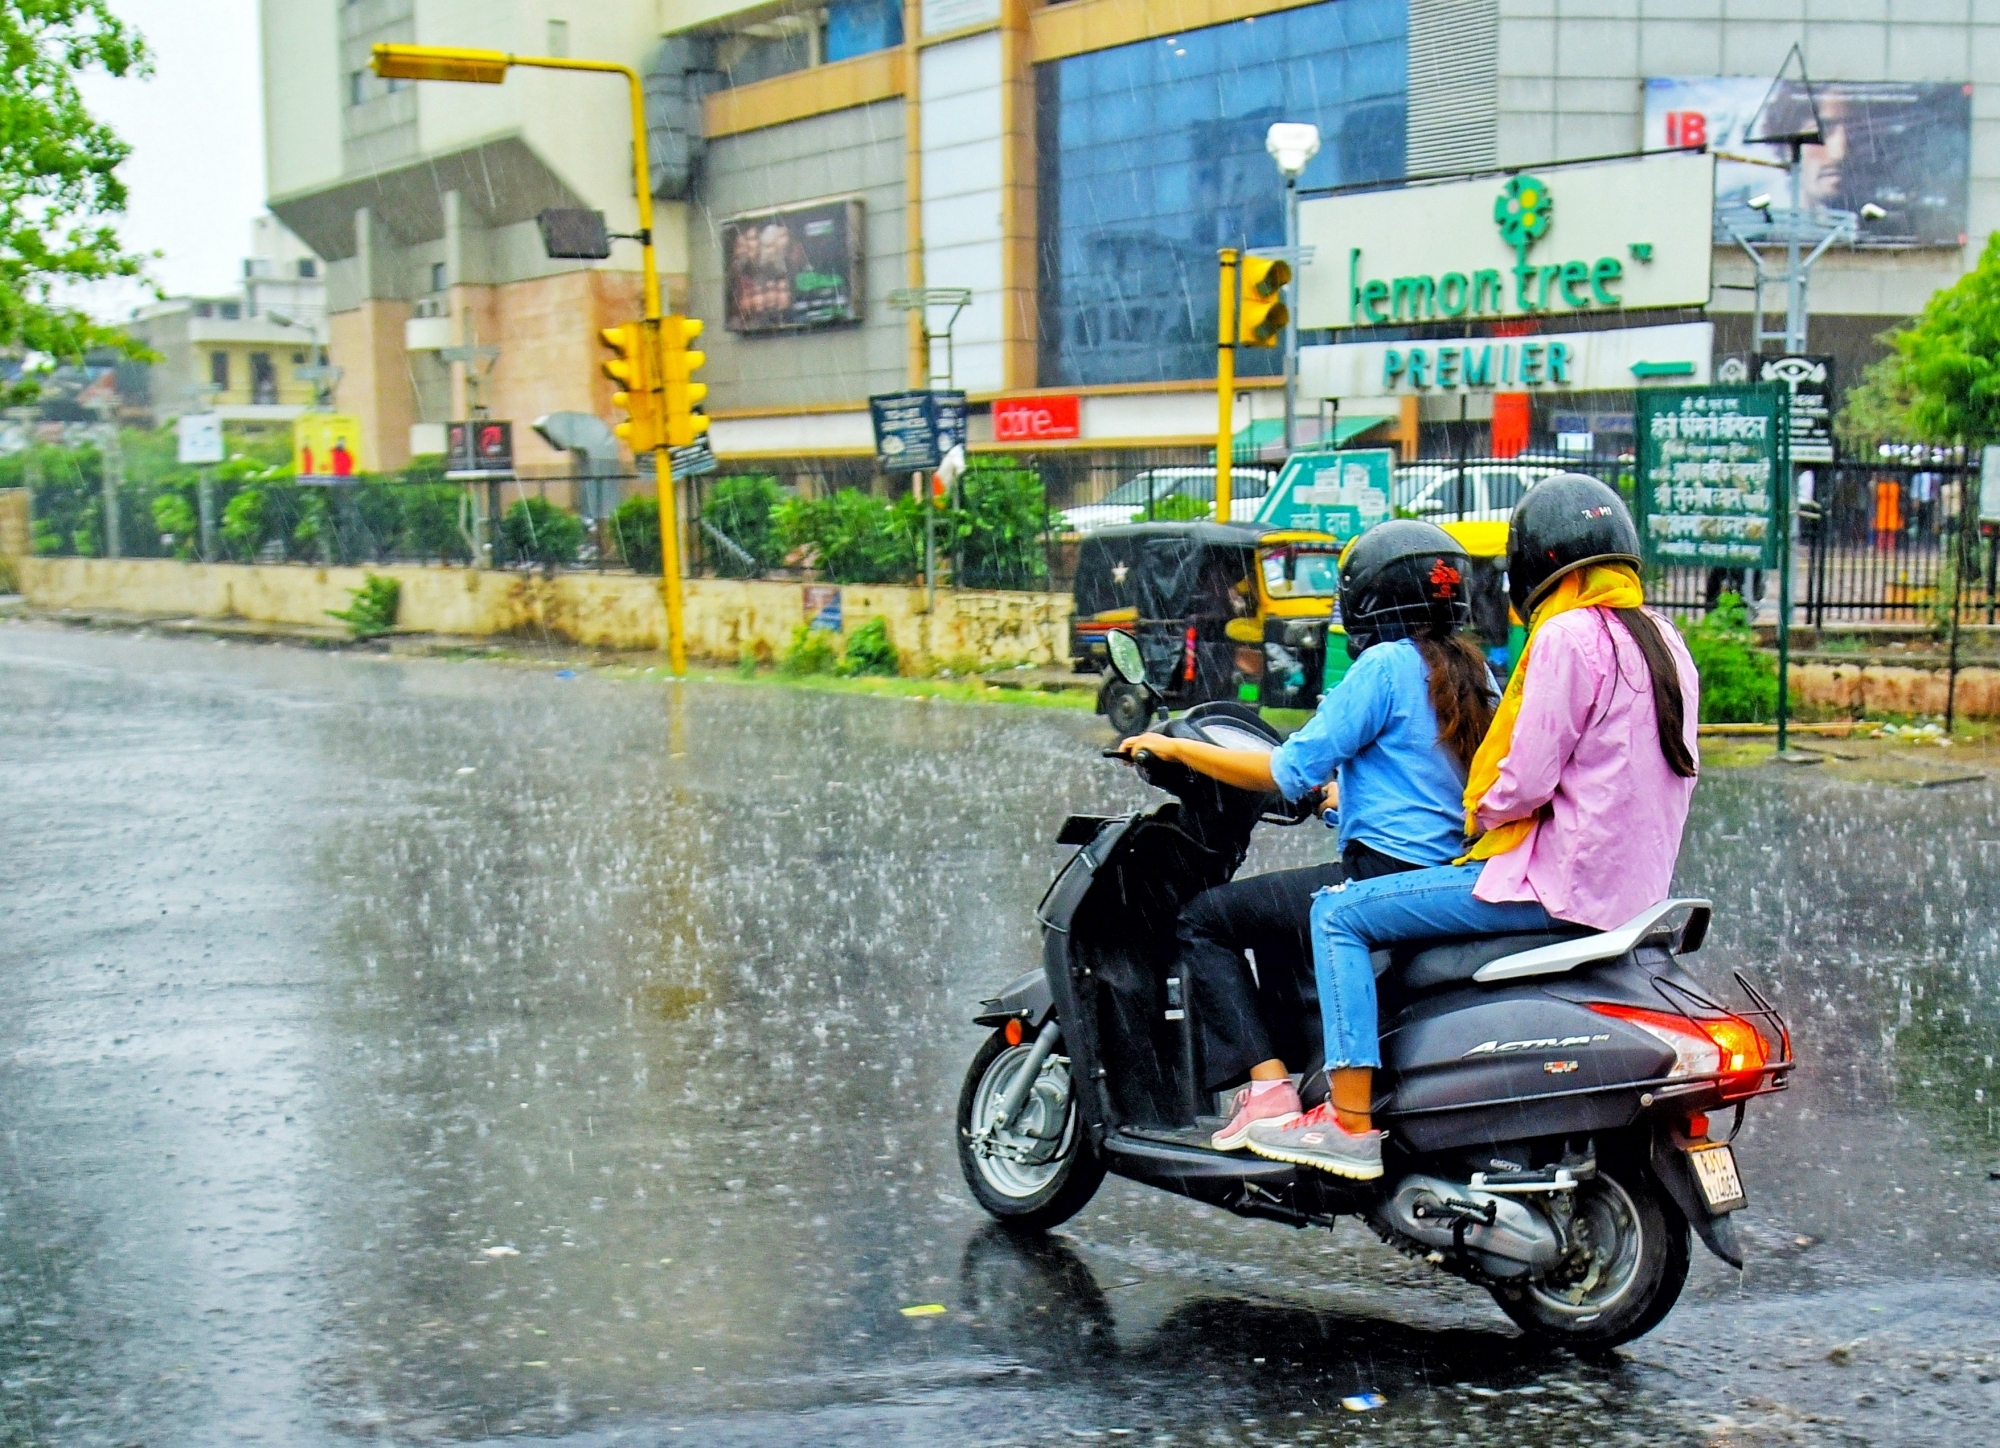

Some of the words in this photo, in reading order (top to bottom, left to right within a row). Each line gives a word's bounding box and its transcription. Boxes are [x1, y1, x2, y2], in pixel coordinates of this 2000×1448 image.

[1665, 111, 1707, 147] IB
[1350, 247, 1503, 324] lemon
[1512, 246, 1623, 313] tree
[1382, 341, 1572, 389] PREMIER
